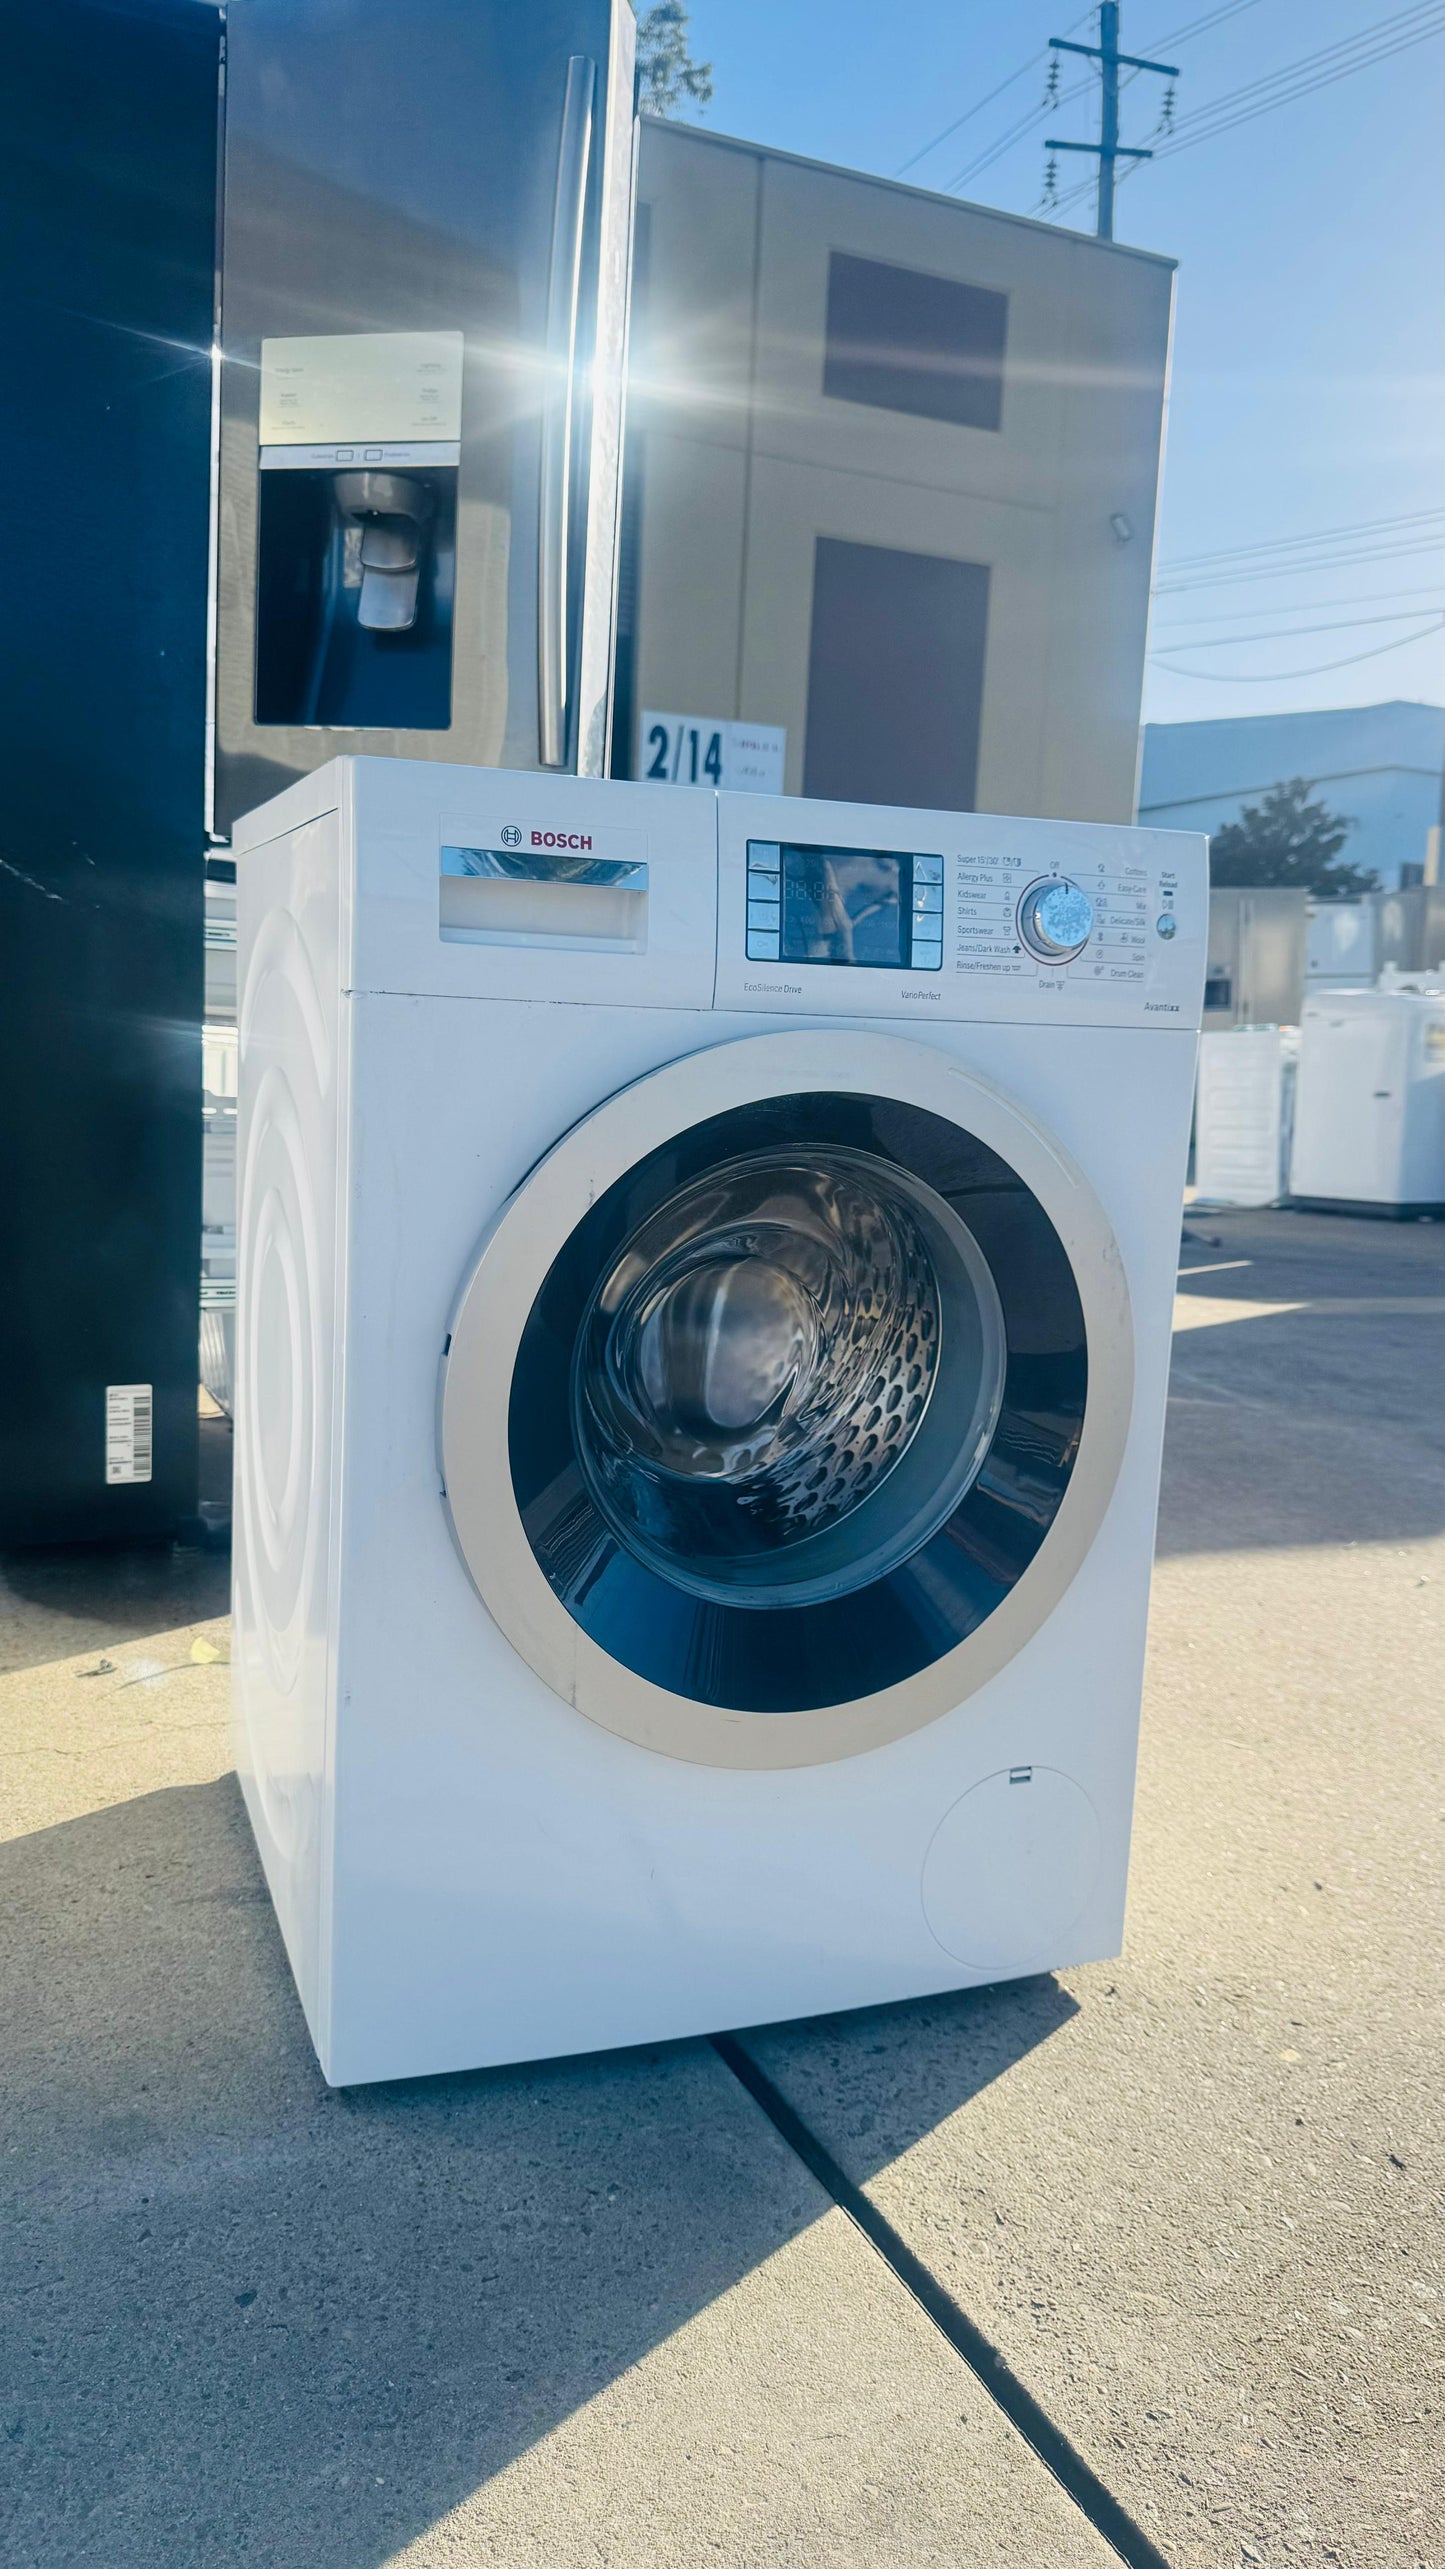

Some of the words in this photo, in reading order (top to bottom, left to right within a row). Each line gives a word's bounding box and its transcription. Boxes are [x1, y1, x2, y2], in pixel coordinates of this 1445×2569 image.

[646, 724, 722, 786] 2/14
[531, 831, 593, 850] BOSCH
[957, 854, 977, 864] Super
[957, 872, 979, 884] Allergy
[980, 874, 994, 882] Plus
[1159, 880, 1178, 889] Reload
[957, 890, 987, 899] Kidswear
[957, 906, 977, 915] Shirts
[957, 925, 994, 935] Sportswear
[994, 946, 1011, 954] Wash
[956, 961, 1002, 971] Rinse/Freshen
[743, 982, 783, 993] EcoSilence
[783, 984, 803, 994] Drive
[1039, 980, 1056, 989] Drain
[1144, 1002, 1180, 1012] Avantixx
